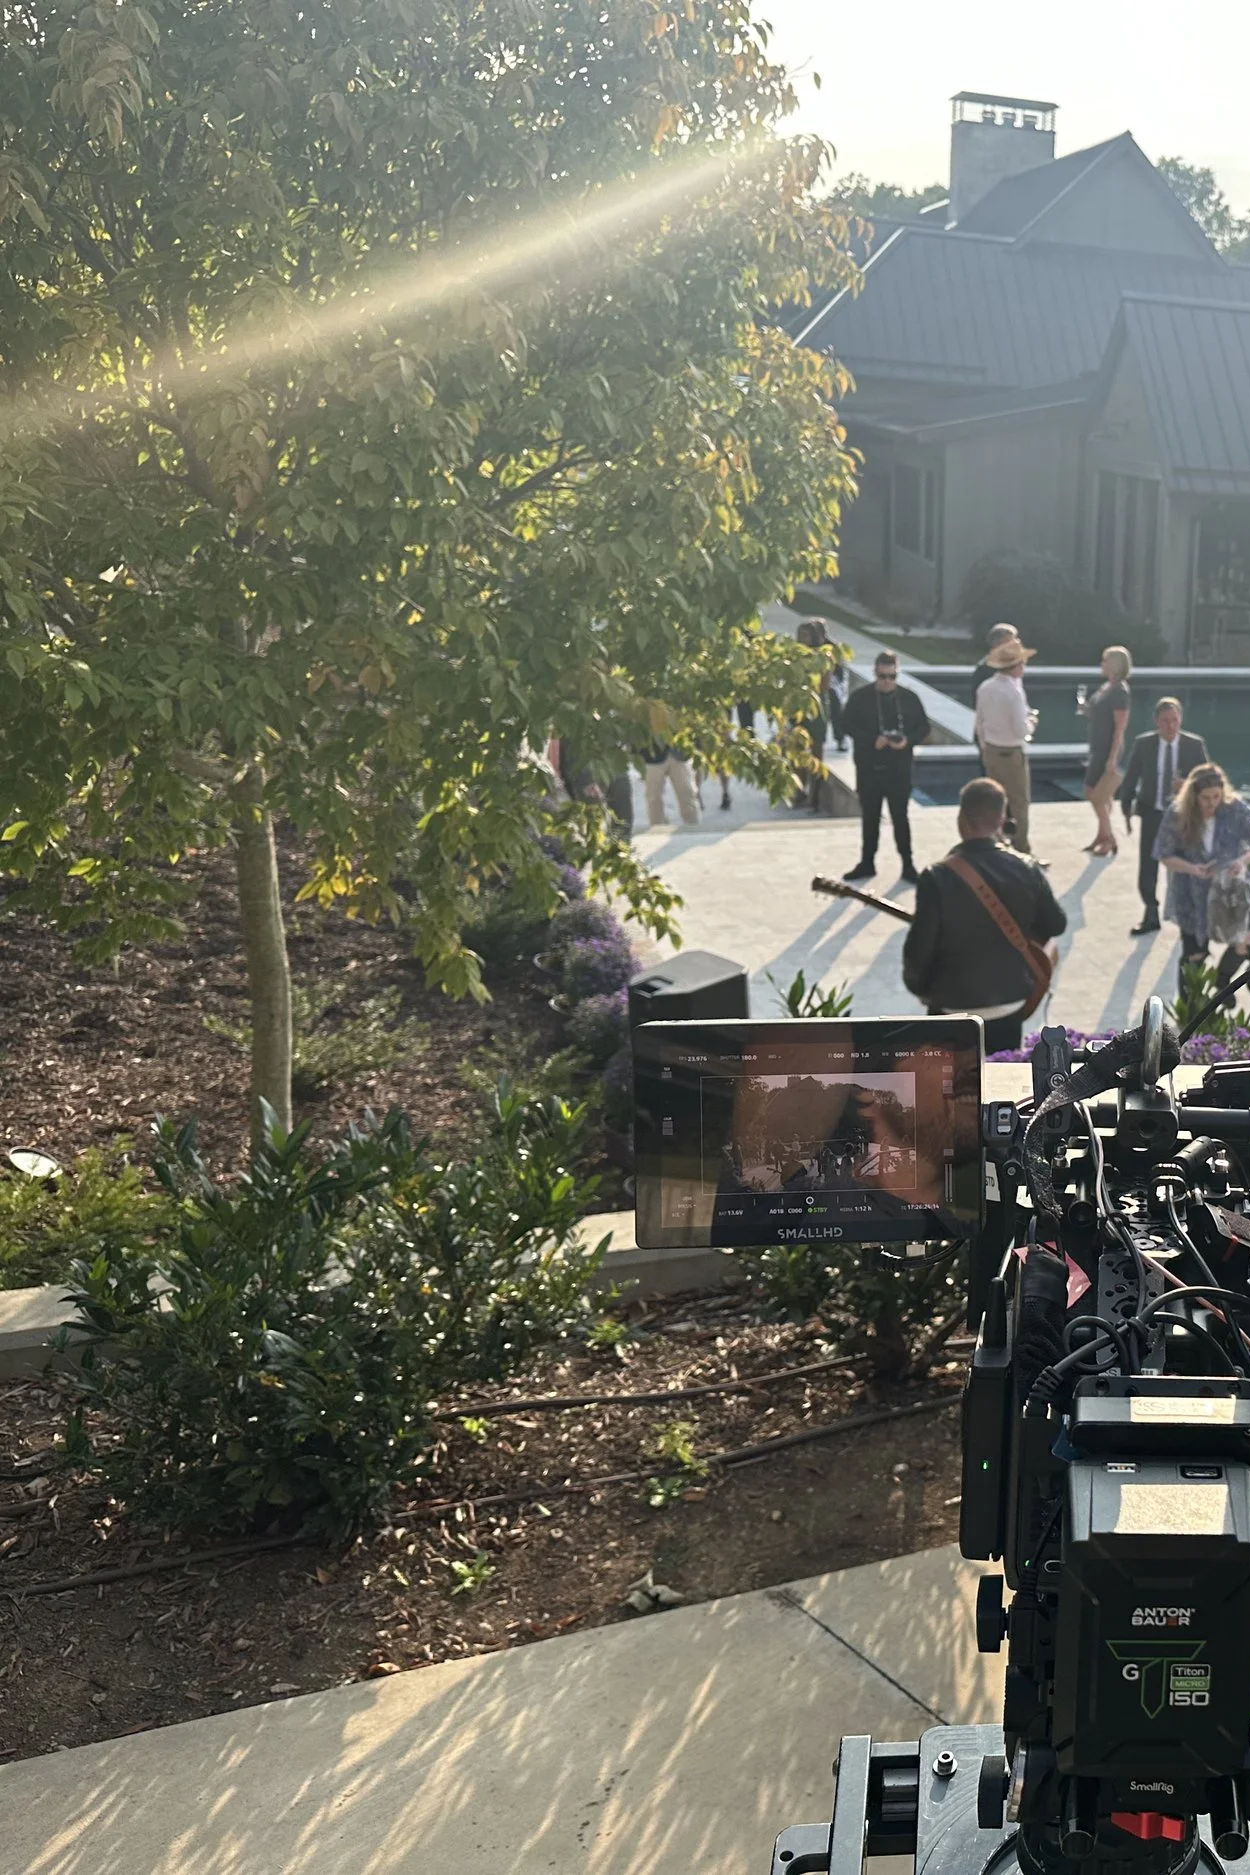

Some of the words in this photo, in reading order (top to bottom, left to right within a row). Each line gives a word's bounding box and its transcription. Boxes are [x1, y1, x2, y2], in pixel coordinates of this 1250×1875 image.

[777, 1226, 843, 1239] SMALLHD
[1122, 1663, 1139, 1681] G
[1175, 1667, 1205, 1676] Titon
[1169, 1691, 1210, 1706] 150
[1130, 1781, 1174, 1795] SmallRig
